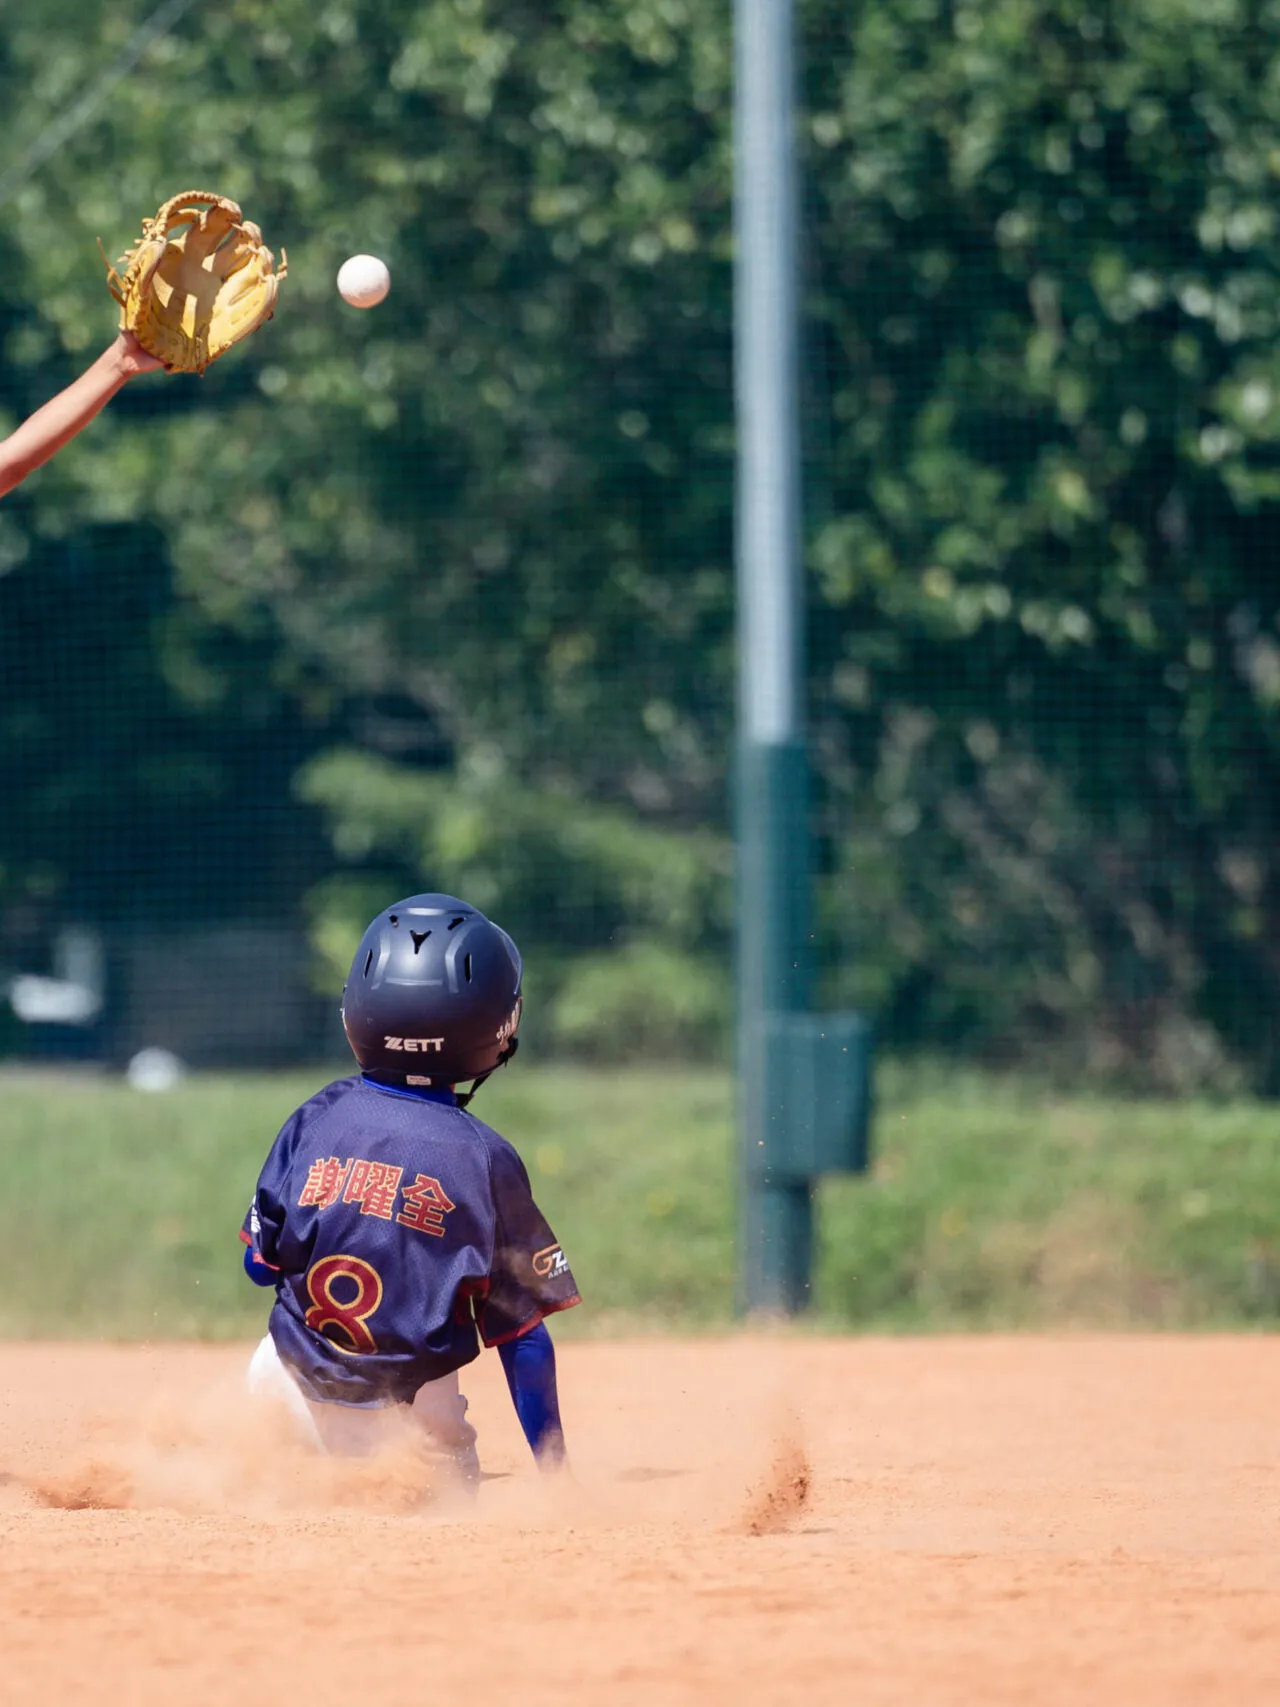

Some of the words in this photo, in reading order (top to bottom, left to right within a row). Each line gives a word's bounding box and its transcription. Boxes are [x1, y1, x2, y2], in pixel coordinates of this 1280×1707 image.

[384, 1036, 445, 1052] ZETT
[297, 1156, 456, 1238] 謝曜全
[305, 1254, 383, 1355] 8
